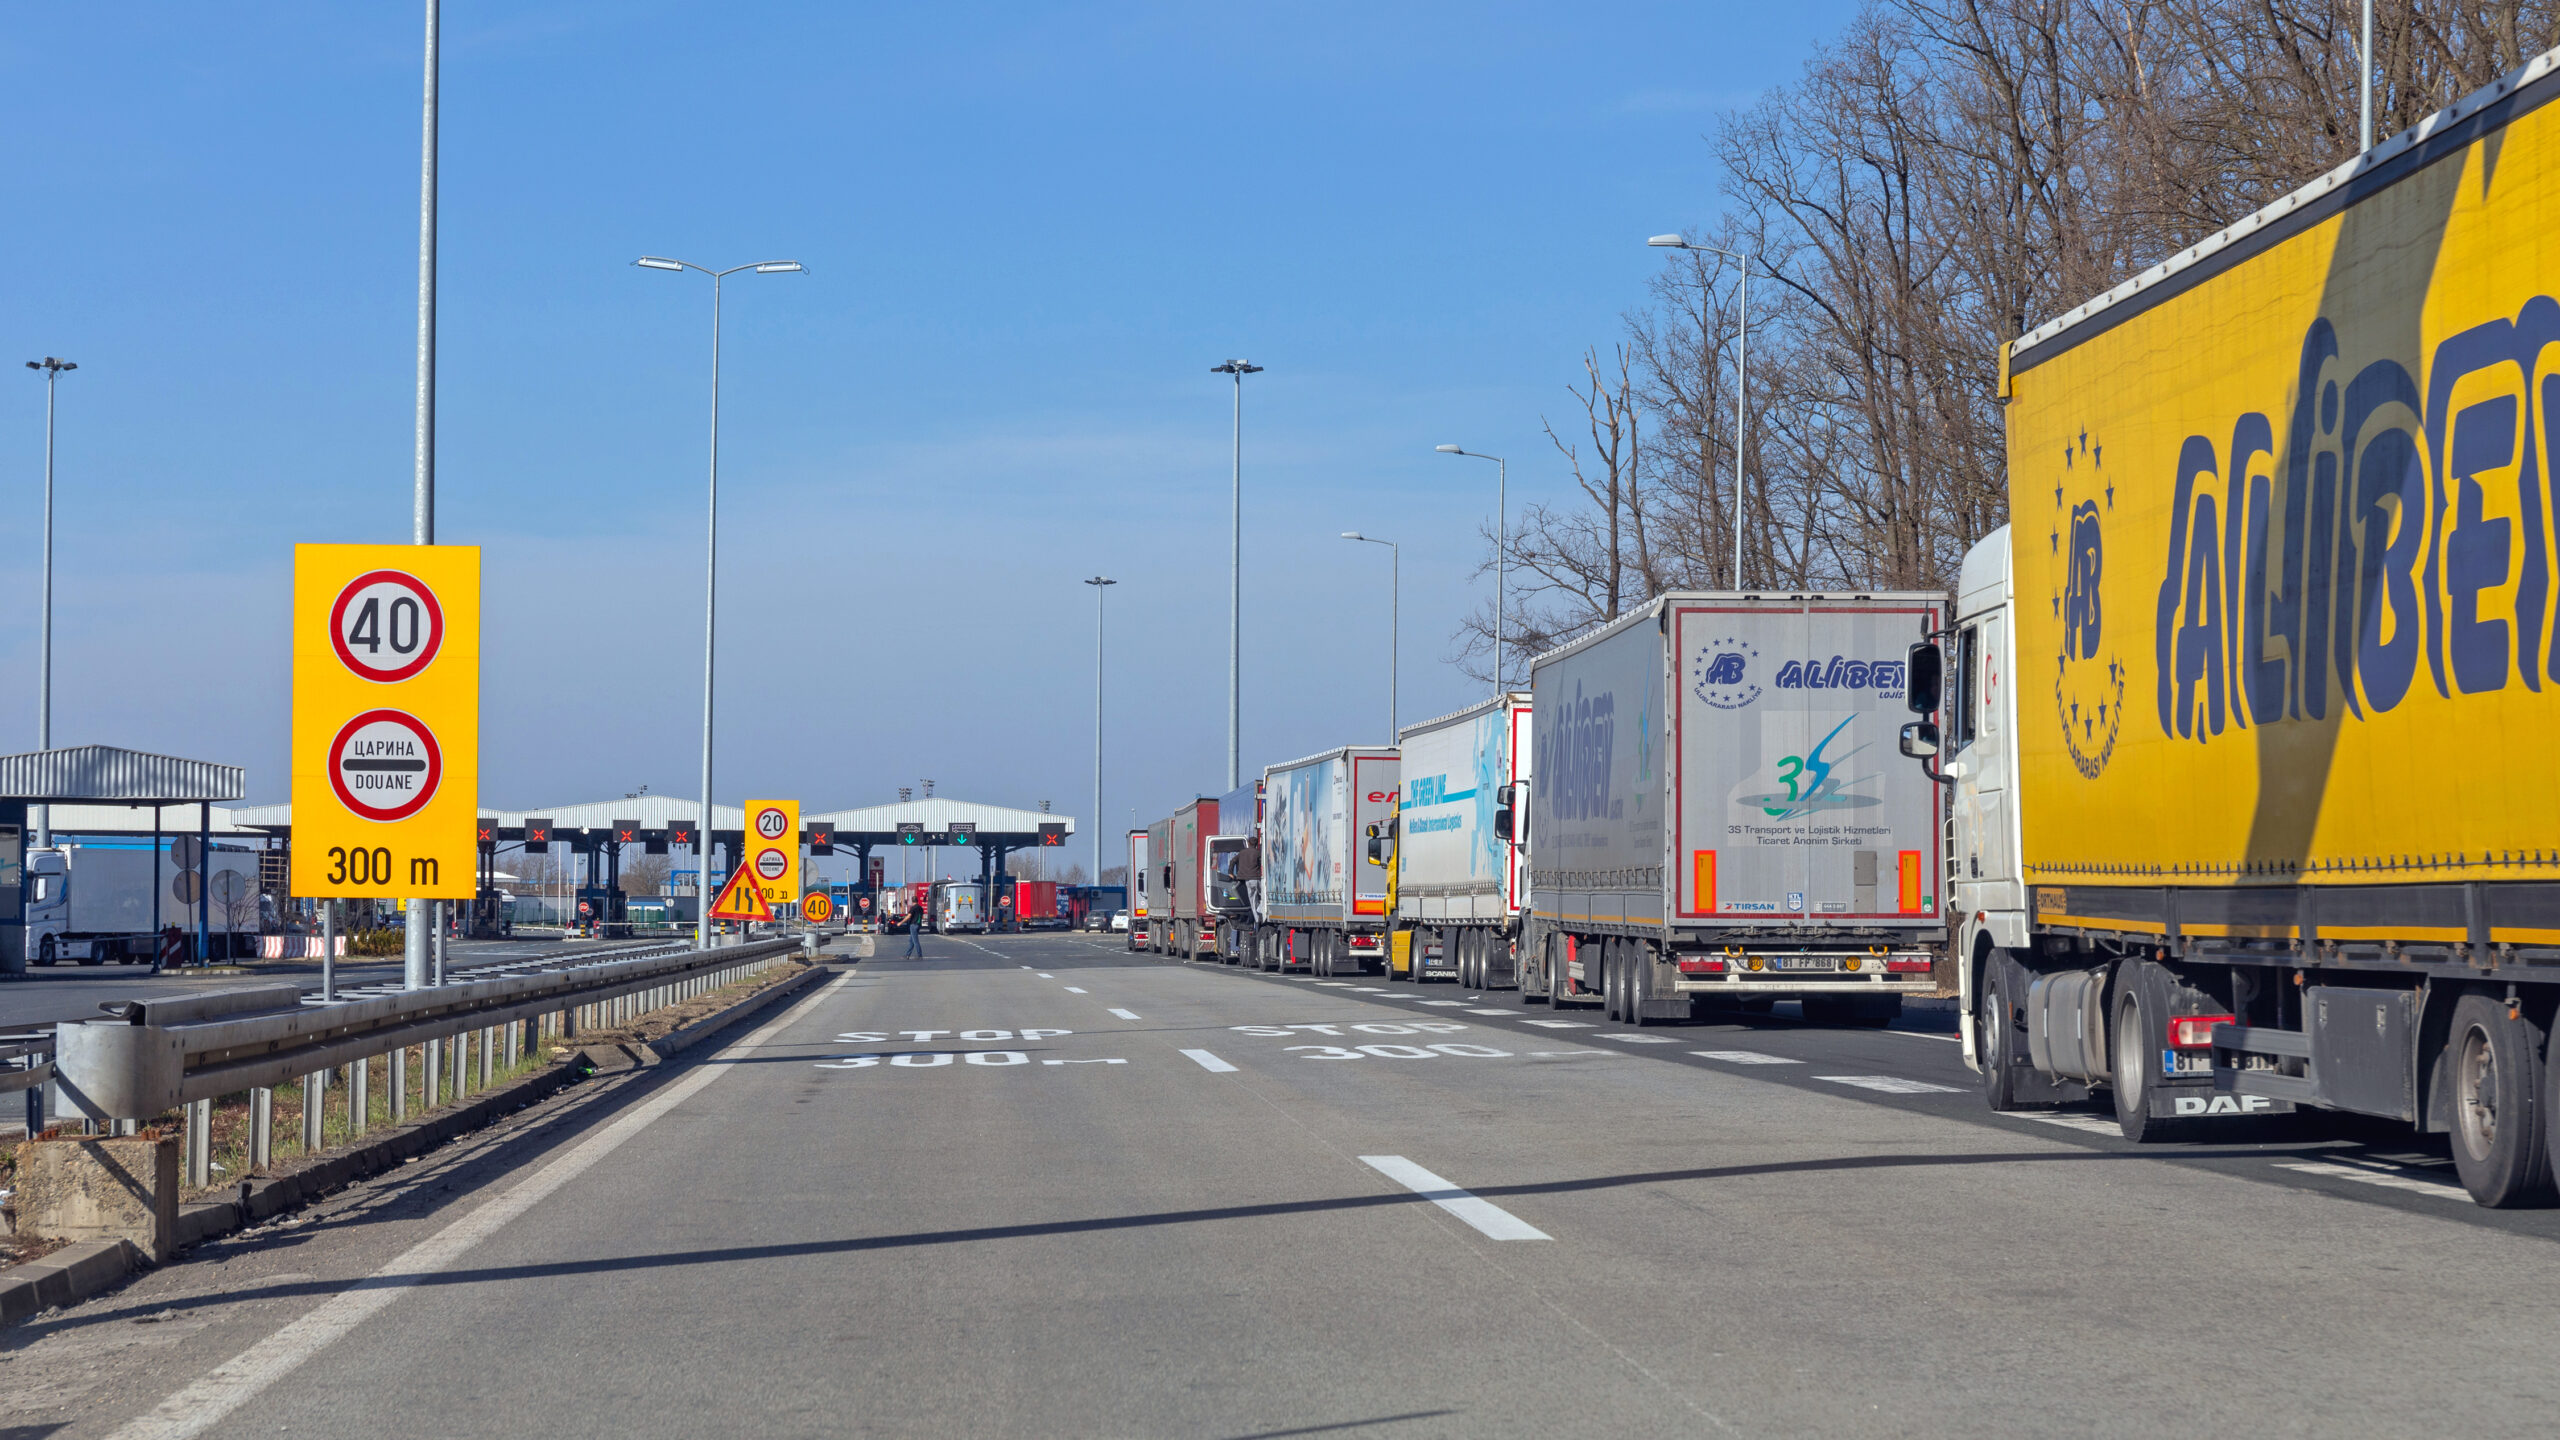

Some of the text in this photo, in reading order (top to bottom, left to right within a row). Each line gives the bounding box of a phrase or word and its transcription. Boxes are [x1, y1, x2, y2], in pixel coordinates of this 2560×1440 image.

[2064, 499, 2103, 663] AB
[349, 596, 419, 654] 40
[1706, 653, 1746, 685] AB
[1879, 690, 1905, 699] LOJİS
[355, 741, 415, 757] ЦАРИНА
[1763, 711, 1860, 822] 3S
[356, 774, 413, 789] DOUANE
[763, 815, 782, 832] 20
[1728, 825, 1742, 834] 3S
[1744, 825, 1791, 836] Transport
[1808, 825, 1841, 836] Lojistik
[1844, 825, 1891, 835] Hizmetleri
[1757, 836, 1790, 845] Ticaret
[1793, 836, 1829, 845] Anonim
[327, 846, 439, 885] 300 m
[808, 900, 827, 915] 40
[1782, 958, 1793, 967] 81
[832, 1029, 1073, 1043] STOP
[1228, 1022, 1468, 1037] STOP
[1282, 1043, 1514, 1060] 300
[813, 1051, 1030, 1069] 300
[2175, 1095, 2271, 1115] DAF
